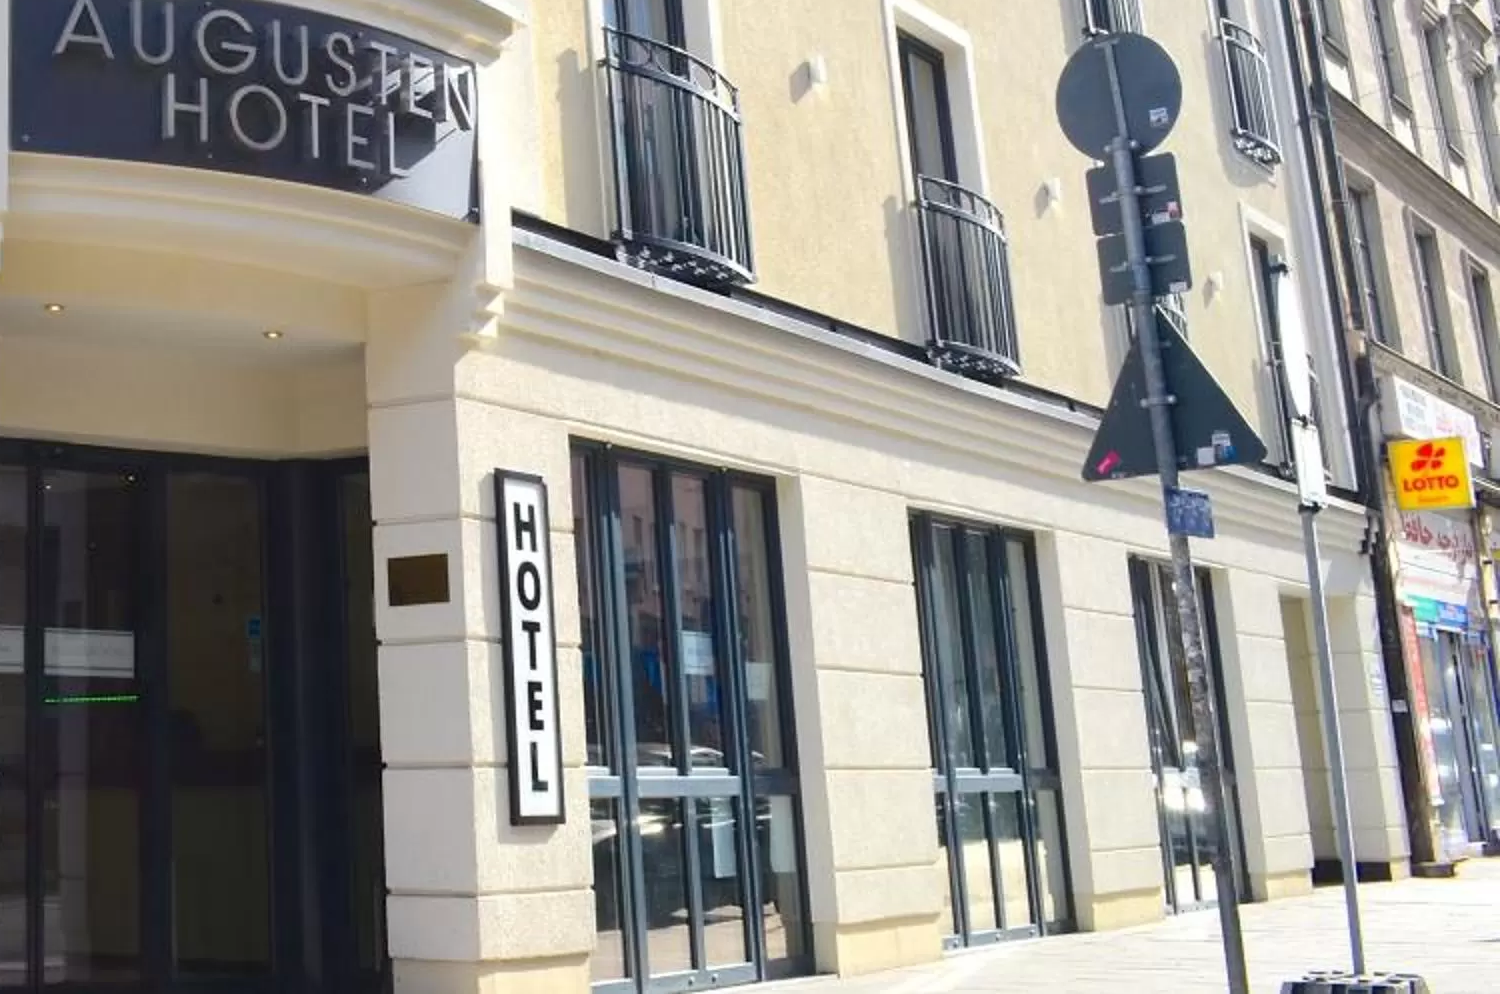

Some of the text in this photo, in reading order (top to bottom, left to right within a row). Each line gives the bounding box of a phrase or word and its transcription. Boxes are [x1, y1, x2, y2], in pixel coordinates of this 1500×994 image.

[161, 73, 409, 178] HOTEL
[1402, 474, 1459, 493] LOTTO
[512, 502, 548, 792] HOTEL
